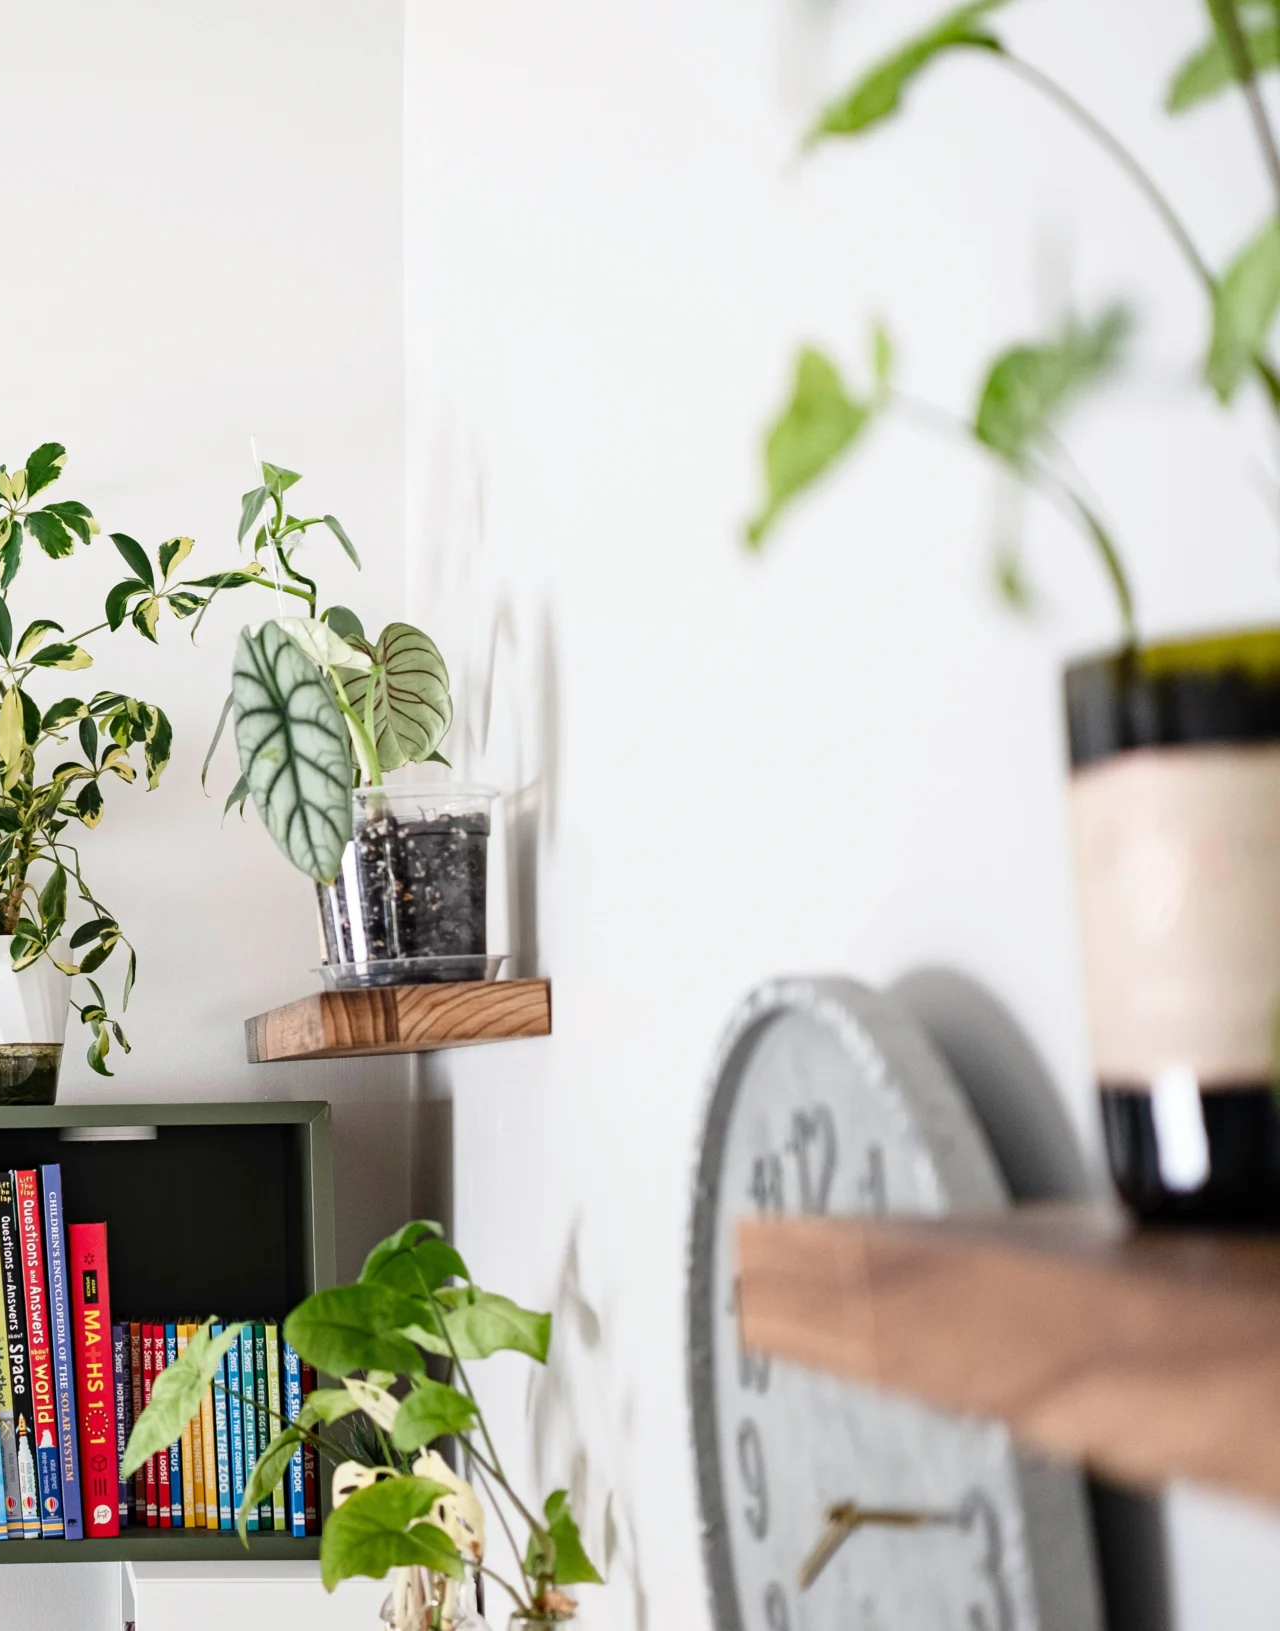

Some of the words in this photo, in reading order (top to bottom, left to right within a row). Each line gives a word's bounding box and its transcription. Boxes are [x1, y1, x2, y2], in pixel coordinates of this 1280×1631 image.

[23, 1200, 38, 1267] Questions
[49, 1191, 60, 1257] CHILDREN'S
[1, 1216, 14, 1270] Questions
[6, 1271, 14, 1283] and
[29, 1270, 38, 1283] and
[6, 1284, 18, 1331] Answers
[53, 1259, 66, 1345] ENCYCLOPEDIA
[29, 1286, 44, 1344] Answers
[115, 1341, 123, 1352] Dr.
[132, 1335, 140, 1346] Dr.
[144, 1337, 152, 1349] Dr.
[155, 1338, 163, 1349] Dr.
[167, 1337, 176, 1349] Dr.
[244, 1340, 252, 1351] Dr.
[256, 1337, 264, 1349] Dr.
[58, 1347, 67, 1361] OF
[115, 1354, 123, 1373] Seuss
[132, 1348, 140, 1367] Seuss
[144, 1351, 152, 1371] Seuss
[155, 1351, 164, 1371] Seuss
[167, 1351, 176, 1366] Seu
[229, 1352, 238, 1372] Seuss
[244, 1353, 252, 1373] Seuss
[256, 1351, 264, 1371] Seuss
[269, 1352, 278, 1372] Seuss
[290, 1353, 299, 1375] Seuss
[9, 1344, 25, 1394] Space
[59, 1364, 69, 1389] THE
[34, 1363, 55, 1424] World
[231, 1377, 239, 1391] THE
[257, 1377, 265, 1407] GREEN
[290, 1381, 299, 1398] DR.
[60, 1392, 71, 1432] SOLAR
[116, 1383, 124, 1420] HORTON
[133, 1387, 141, 1422] SNEETCHE
[246, 1403, 254, 1420] CAT
[271, 1376, 280, 1431] SCRAMED
[216, 1402, 227, 1431] RAN
[233, 1409, 240, 1418] IN
[258, 1410, 266, 1433] EGGS
[117, 1423, 125, 1452] HEARS
[246, 1422, 254, 1433] IN
[170, 1441, 179, 1472] IRCUS
[217, 1433, 228, 1460] THE
[63, 1434, 74, 1482] SYSTEM
[248, 1453, 256, 1470] HAT
[304, 1451, 314, 1479] ABC
[160, 1455, 169, 1485] LOOSE!
[218, 1464, 229, 1493] ZOO
[293, 1465, 302, 1493] BOOK
[736, 1415, 769, 1542] 9
